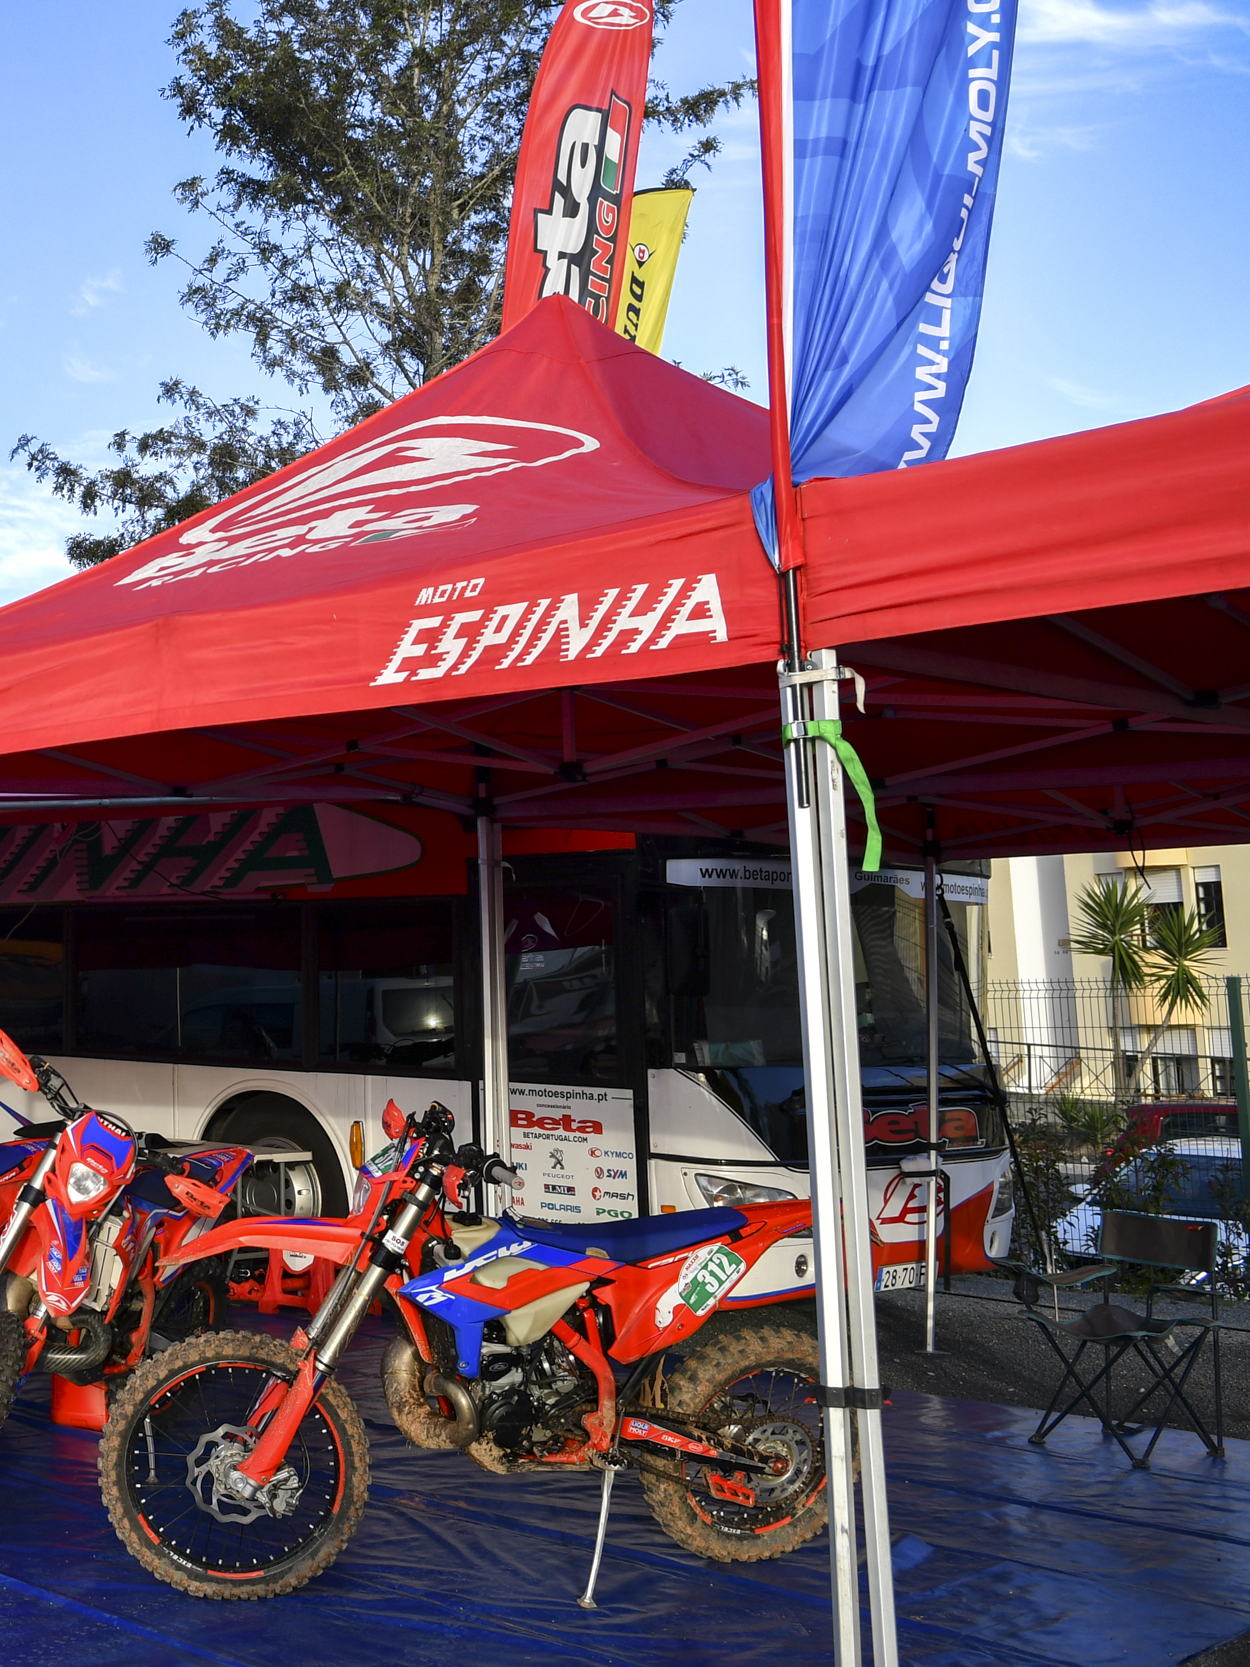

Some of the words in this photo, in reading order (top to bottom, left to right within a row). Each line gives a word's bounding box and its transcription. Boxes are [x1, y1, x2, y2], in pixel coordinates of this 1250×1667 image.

[113, 504, 480, 586] Beta
[133, 538, 353, 590] RACING
[414, 577, 485, 606] MOTO
[369, 574, 729, 686] ESPINHA
[700, 864, 792, 885] www.betapor
[854, 871, 910, 885] Guimarães
[510, 1088, 608, 1103] ww.motoespinha.pt
[510, 1110, 603, 1135] Beta
[522, 1131, 588, 1144] BETAPORTUGAL.COM
[603, 1150, 634, 1160] KYMCO
[543, 1171, 575, 1180] PEUGEOT
[606, 1169, 628, 1180] SYM
[186, 1191, 211, 1211] Beta
[540, 1202, 581, 1213] POLARIS
[595, 1208, 633, 1219] PGO
[697, 1252, 737, 1293] 312
[629, 1426, 647, 1437] MOLY
[631, 1420, 650, 1431] LIQUI
[661, 1434, 681, 1444] SKF
[169, 1550, 194, 1570] EXCEL
